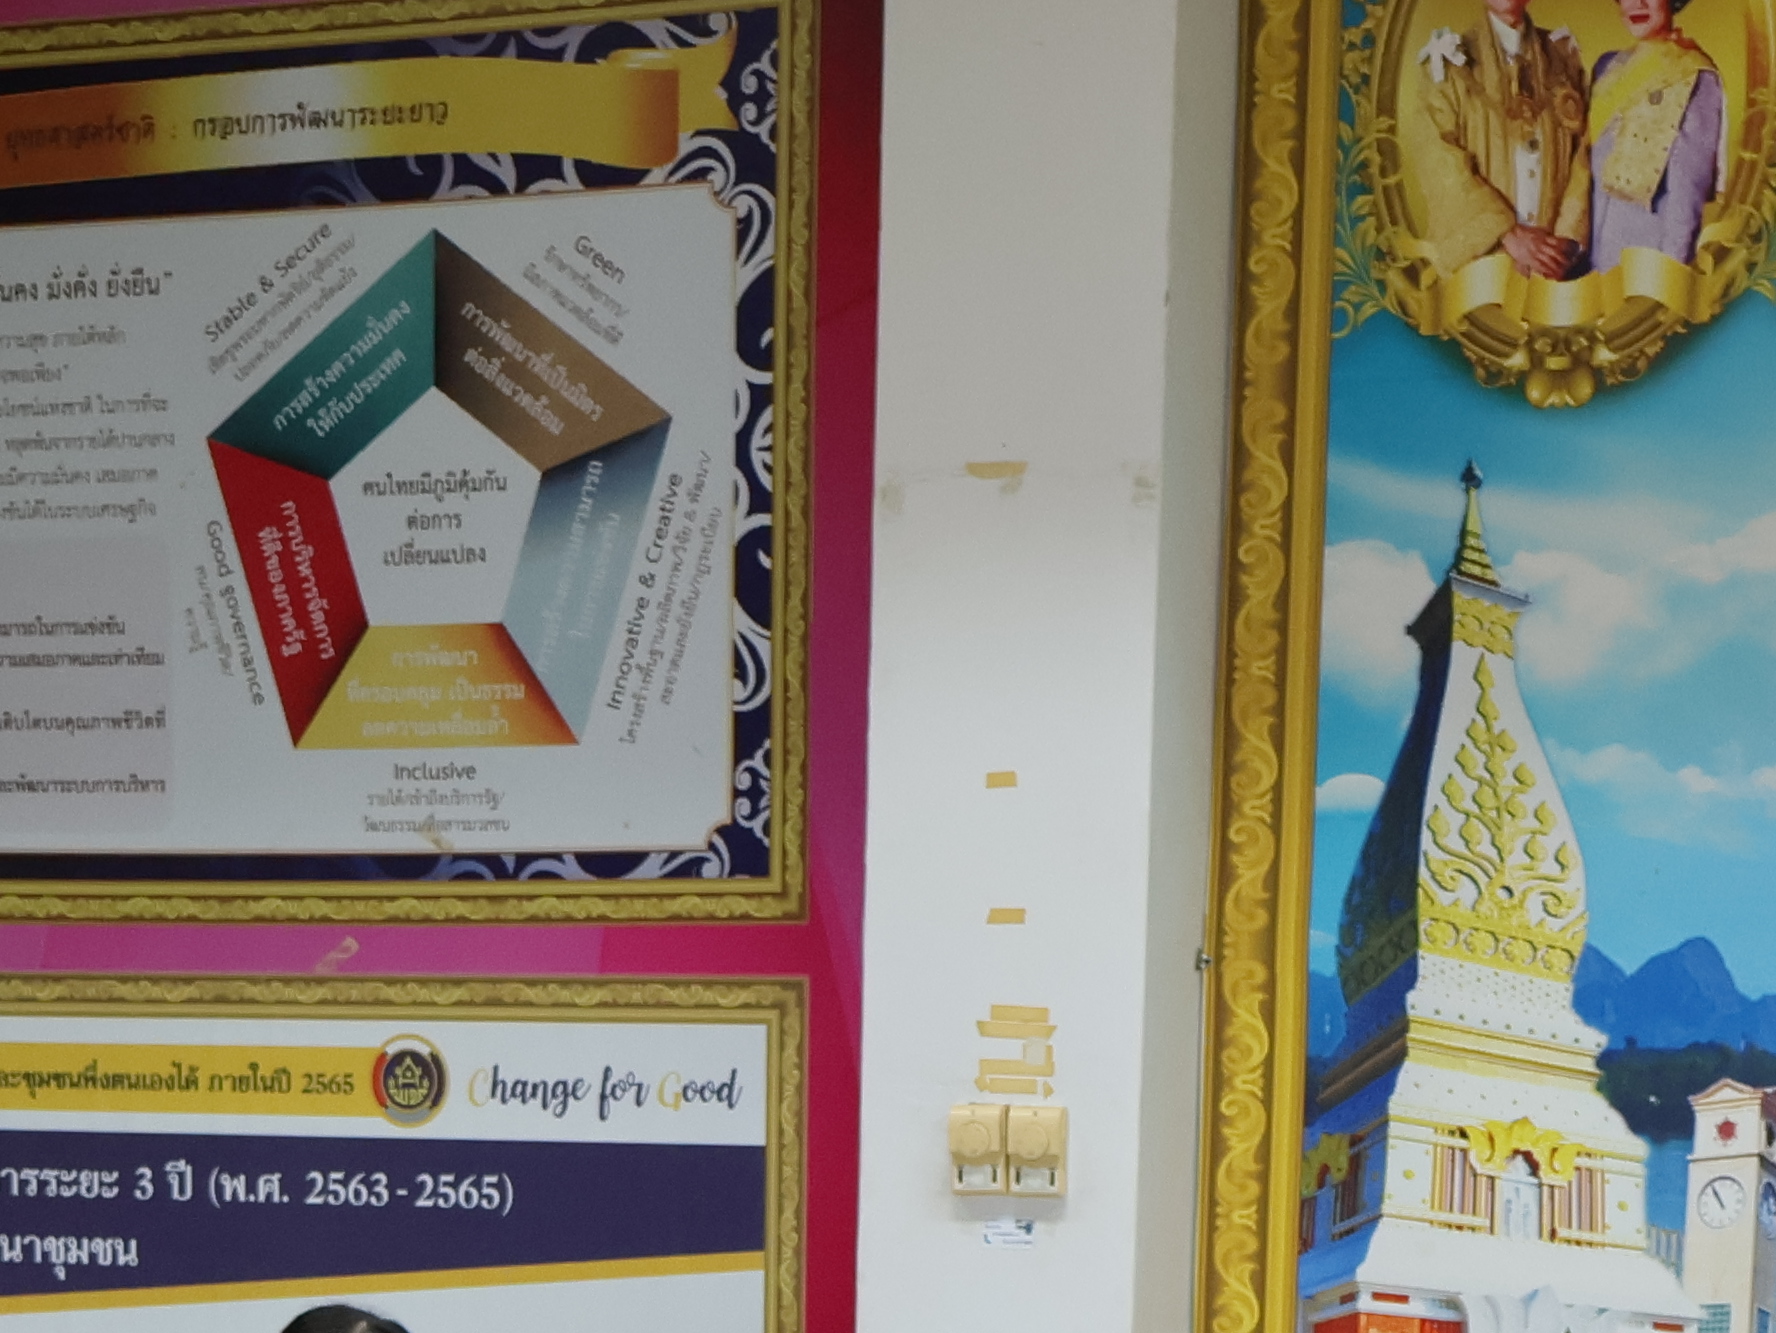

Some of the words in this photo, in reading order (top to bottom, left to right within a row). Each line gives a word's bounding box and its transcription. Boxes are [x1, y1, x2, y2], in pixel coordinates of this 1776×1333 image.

[193, 100, 449, 139] กรอบการพัฒนาระยะยาว
[204, 291, 259, 343] Stable
[258, 274, 275, 294] &
[274, 222, 333, 278] Secure
[574, 235, 625, 284] Green
[362, 468, 508, 503] คนไทยมีภูมิคุ้มกัน
[407, 509, 462, 532] ต่อการ
[646, 473, 684, 565] Creative
[207, 519, 235, 579] Good
[383, 542, 487, 568] เปลี่ยนแปลง
[639, 572, 657, 590] &
[220, 583, 265, 707] governance
[607, 595, 651, 712] Innovative
[393, 762, 477, 781] Inclusive
[207, 1061, 292, 1096] ภายในปี
[301, 1072, 356, 1096] 2565
[468, 1063, 591, 1119] Change
[598, 1065, 650, 1121] for
[656, 1063, 743, 1112] Good
[133, 1167, 155, 1202] 3
[164, 1158, 194, 1202] ปี
[207, 1167, 290, 1209] (พ.ศ.
